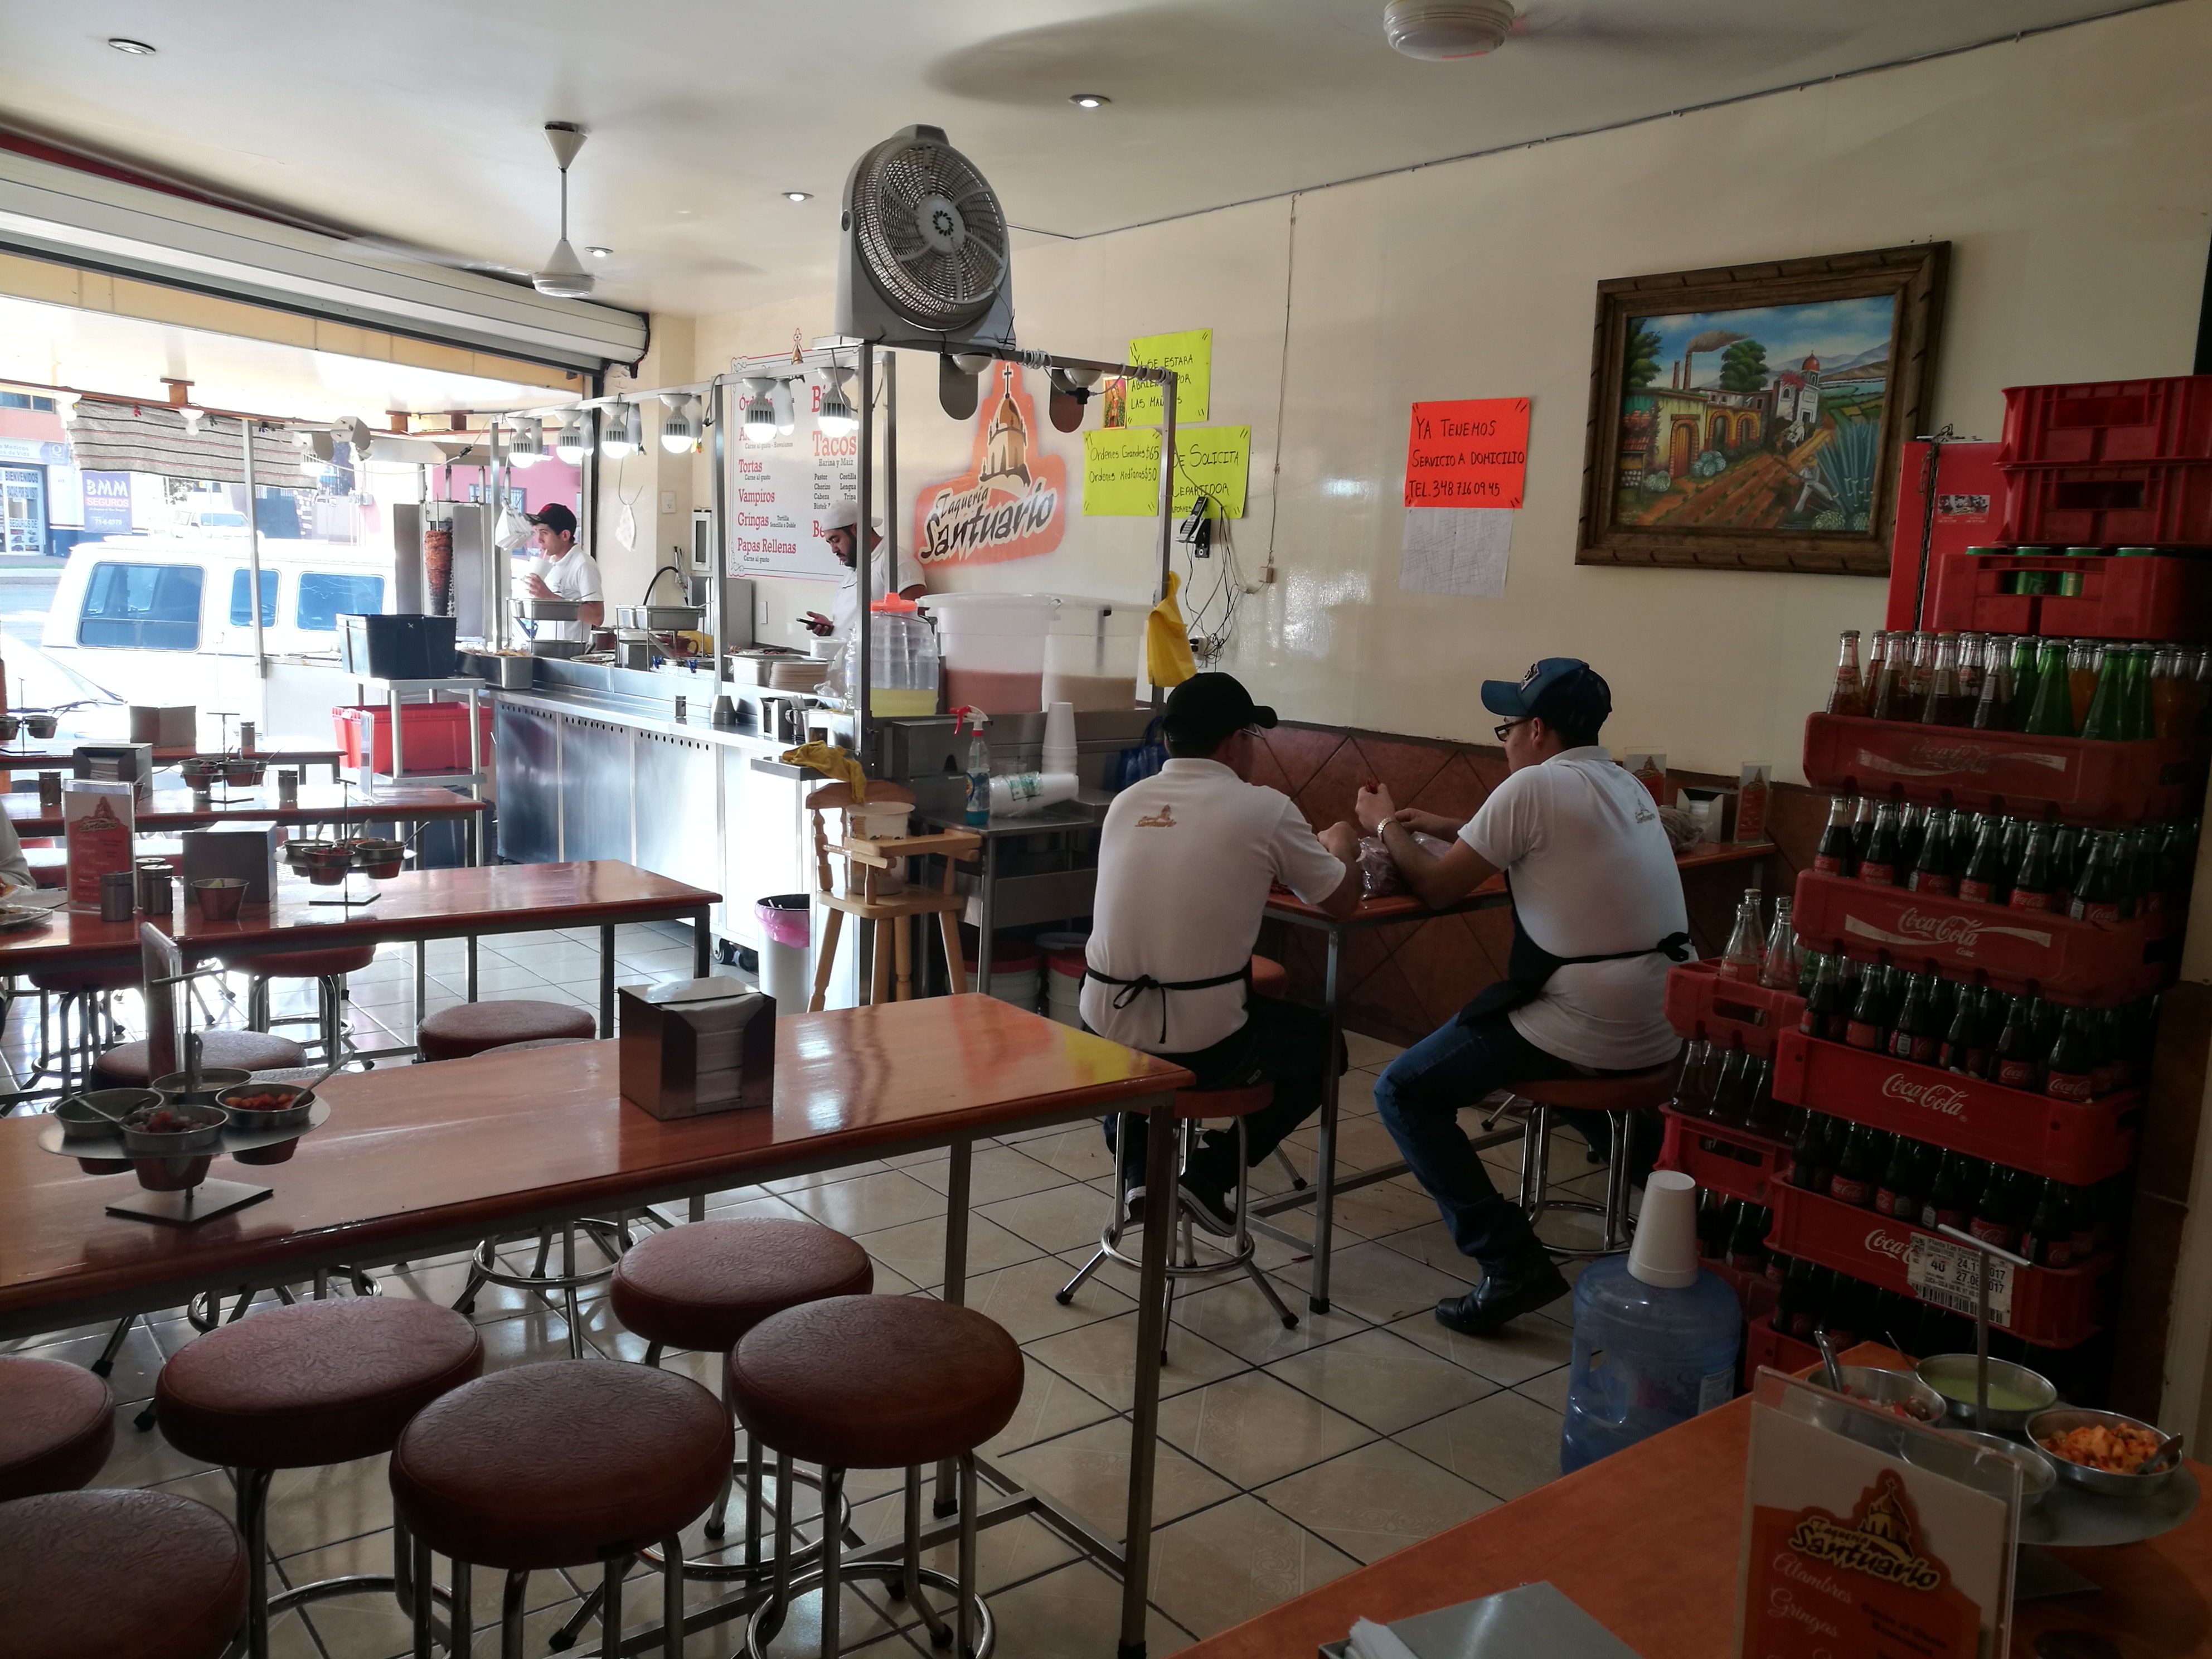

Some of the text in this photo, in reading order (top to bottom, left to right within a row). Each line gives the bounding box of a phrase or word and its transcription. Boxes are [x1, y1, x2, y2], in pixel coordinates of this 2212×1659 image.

[1165, 354, 1193, 367] ESTARA
[1131, 399, 1145, 409] LAS
[1417, 416, 1496, 439] YA TENEMOS
[812, 430, 857, 457] Tacos
[1122, 445, 1145, 458] Grandes
[1146, 445, 1159, 461] $65
[1190, 444, 1239, 467] SOLICITA
[1411, 449, 1524, 467] SERVICIO A DOMICILIO
[739, 459, 762, 473] Tortas
[1144, 465, 1157, 482] $50
[5, 471, 38, 483] BIENVENIDOS
[86, 479, 128, 497] BMM
[840, 483, 856, 492] Lengua
[1409, 481, 1500, 497] TEL. 348 716 09 45
[87, 498, 129, 507] SEGUROS
[738, 488, 775, 506] Vampiros
[738, 512, 769, 530] Gringas
[920, 482, 1054, 559] Santuario
[738, 537, 796, 555] Papas Rellenas
[1898, 907, 1983, 947] Coca-Cola
[1882, 1073, 1970, 1115] Coca-Cola
[1791, 1524, 1938, 1588] Santuario
[1773, 1549, 1852, 1604] Alambres
[1767, 1585, 1839, 1639] Gringas
